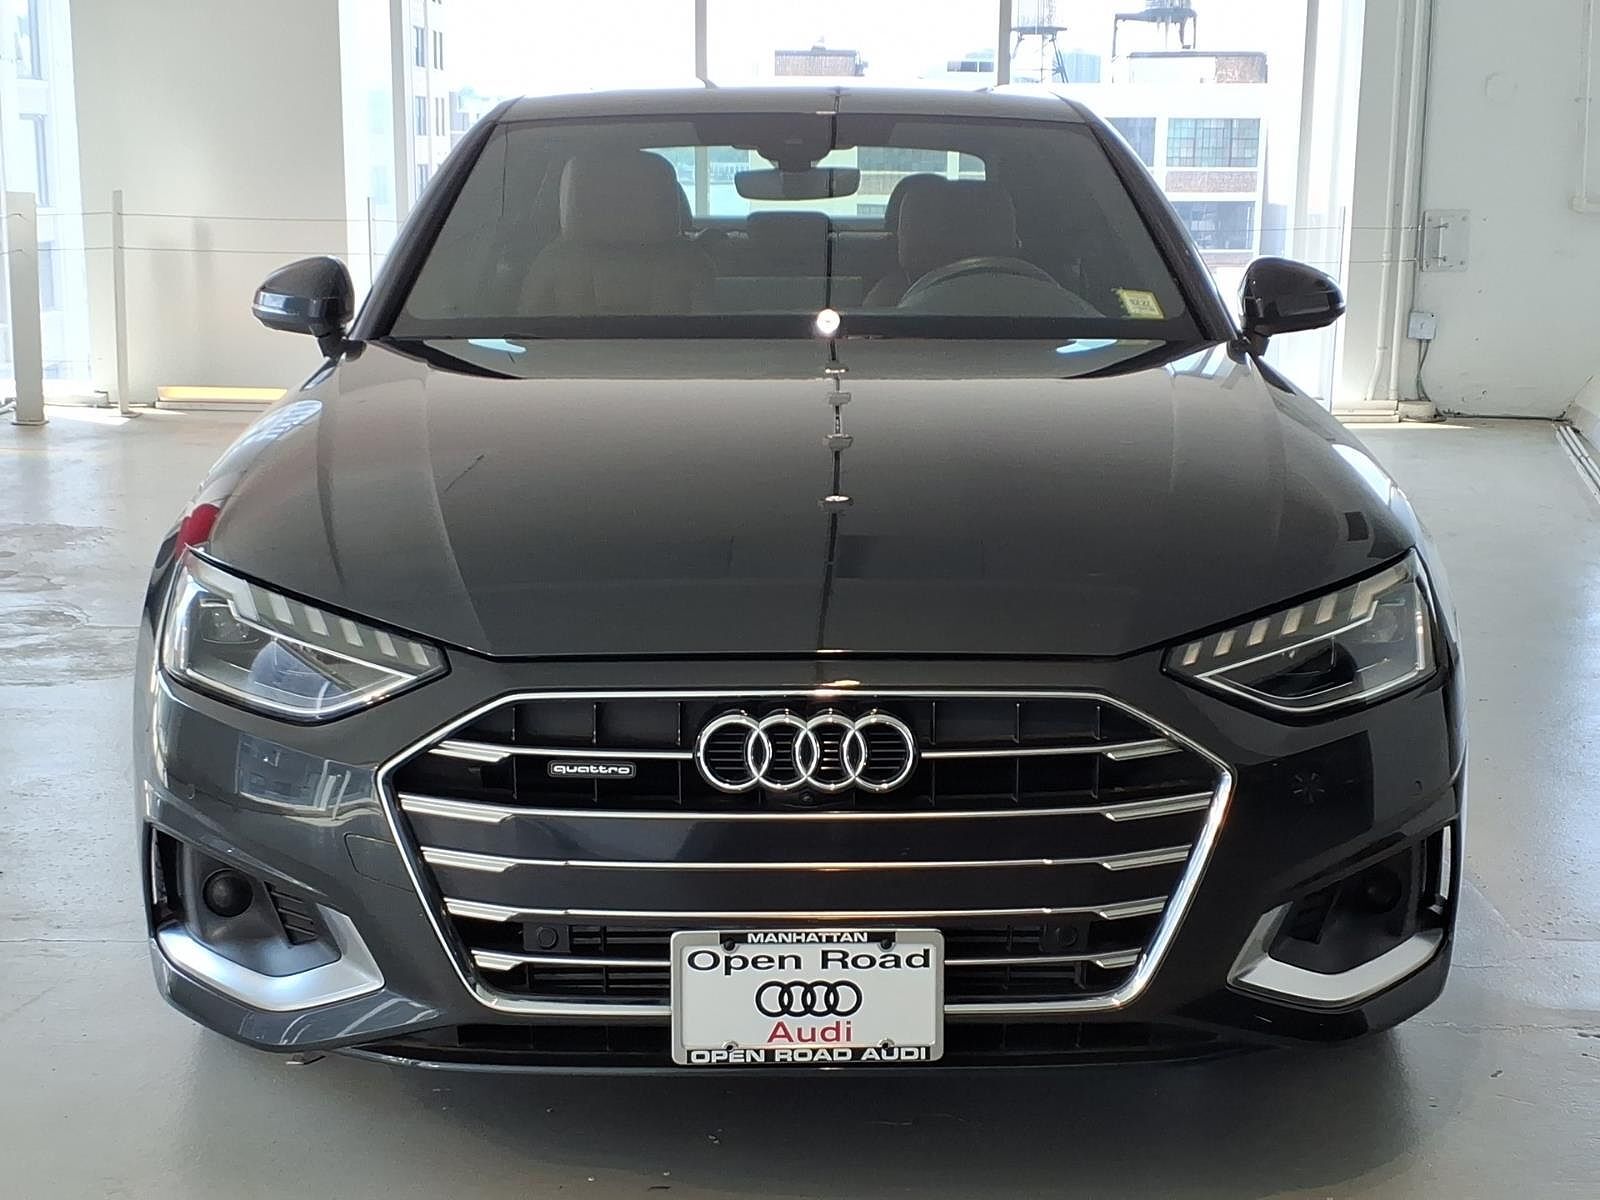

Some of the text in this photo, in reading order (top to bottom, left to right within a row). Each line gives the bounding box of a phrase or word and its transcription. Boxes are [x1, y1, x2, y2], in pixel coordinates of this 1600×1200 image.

[553, 765, 630, 774] quattro
[747, 932, 868, 944] MANHATTAN
[687, 948, 931, 976] Open Road
[767, 1021, 852, 1043] Audi
[690, 1047, 926, 1063] OPEN ROAD AUDI
